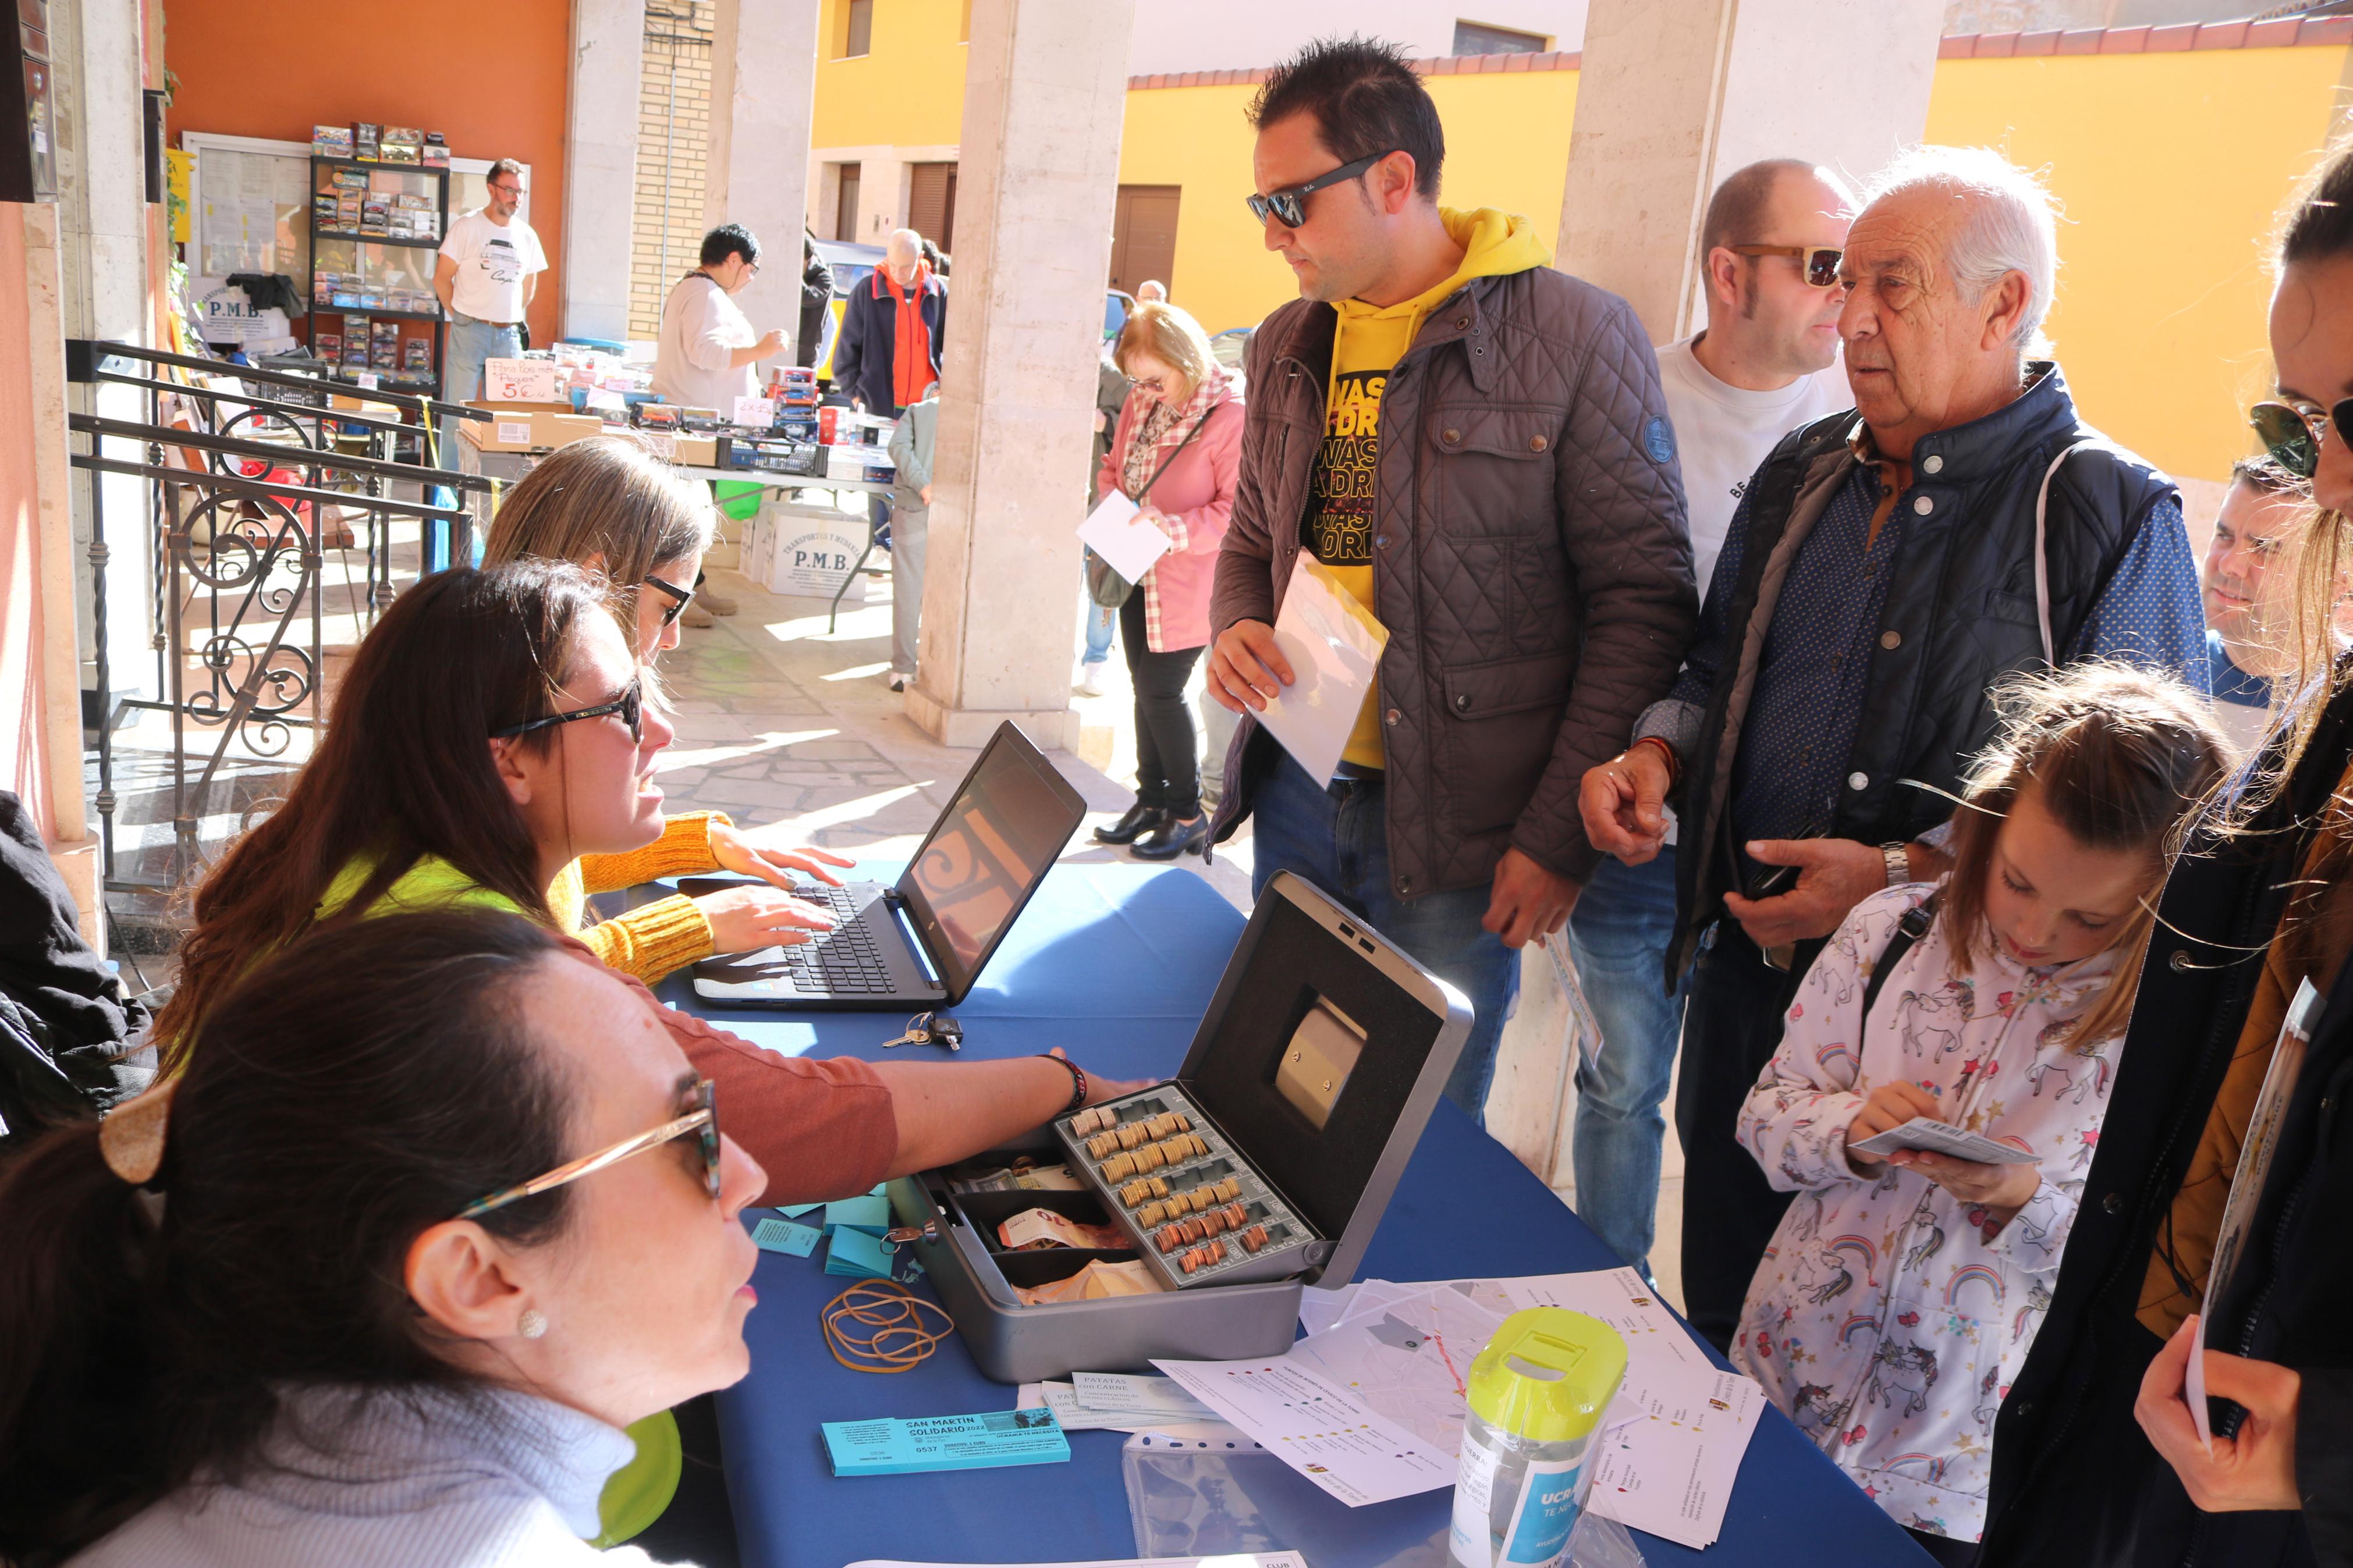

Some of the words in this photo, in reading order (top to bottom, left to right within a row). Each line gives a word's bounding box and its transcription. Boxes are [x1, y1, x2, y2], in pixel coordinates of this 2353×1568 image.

[489, 361, 516, 372] Para
[519, 361, 535, 373] los
[794, 551, 850, 571] P.M.B.
[1234, 1162, 1248, 1172] CENTS
[1253, 1181, 1267, 1193] CENTS
[1272, 1203, 1286, 1214] CENTS
[1037, 1211, 1066, 1226] 10
[1293, 1226, 1308, 1237] CENTS
[1229, 1247, 1245, 1260] CENTS
[932, 1417, 975, 1426] MARTÍN
[910, 1426, 964, 1436] SOLIDARIO
[1545, 1508, 1557, 1517] TE
